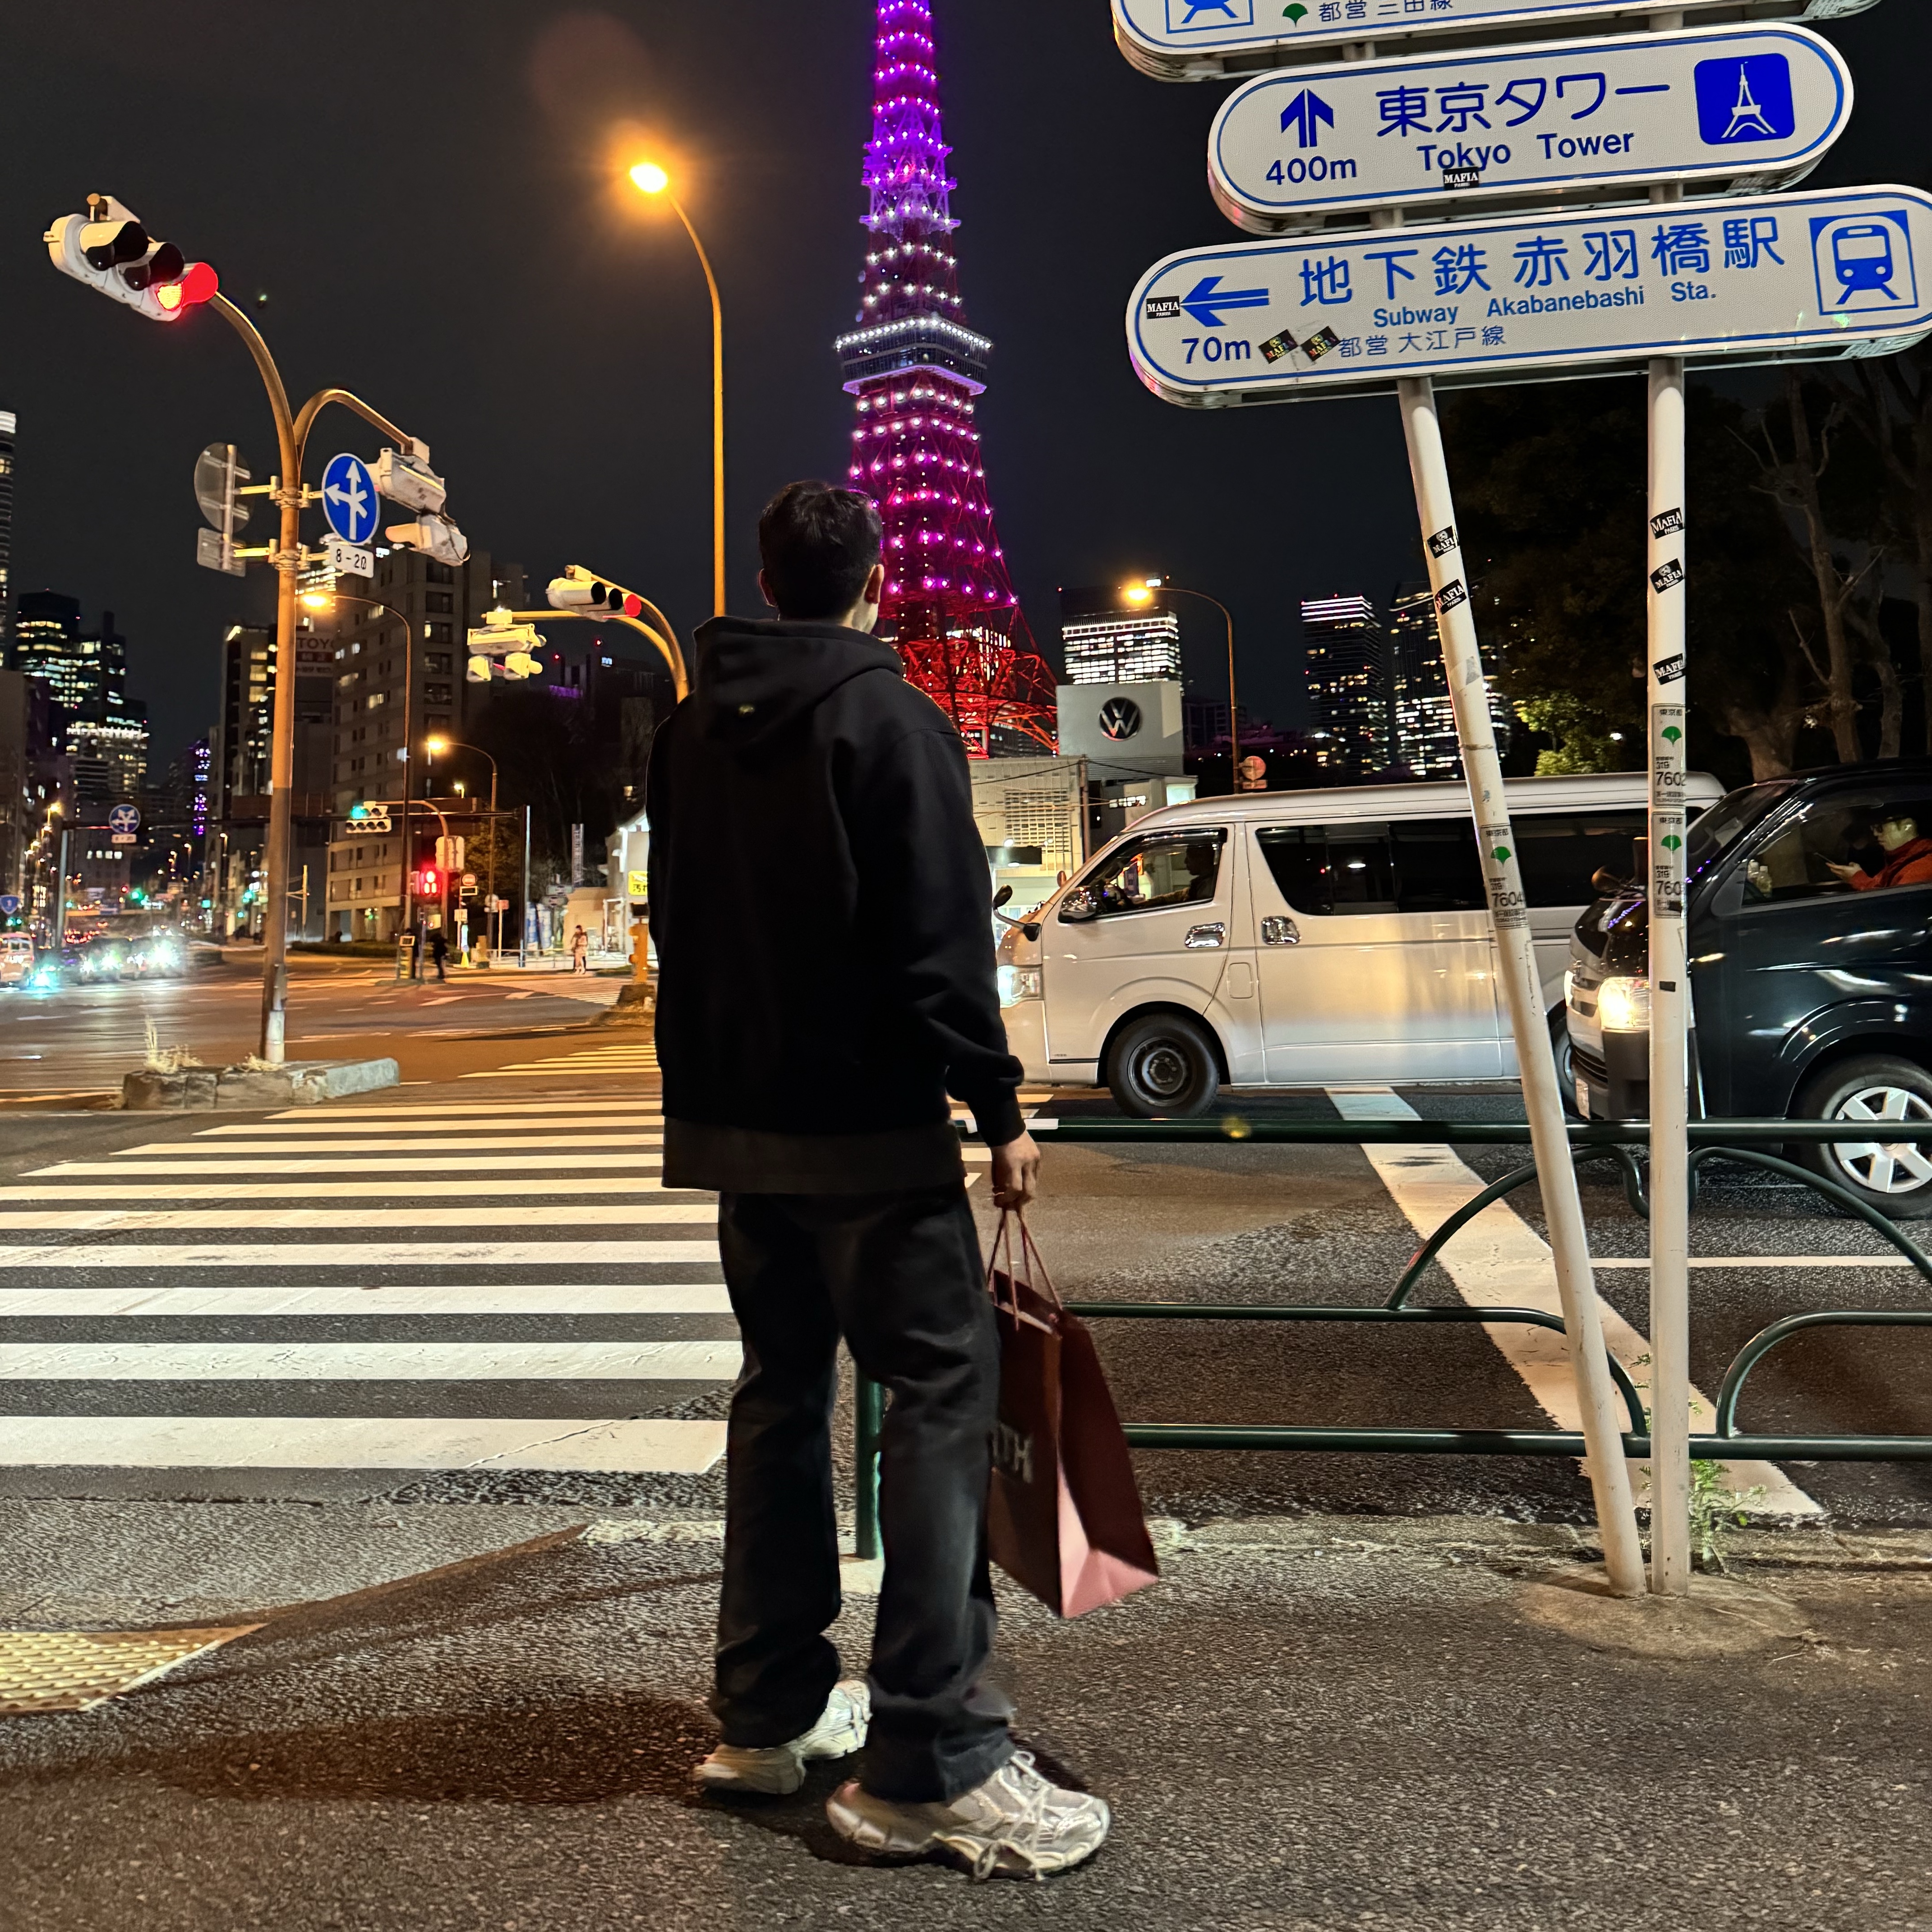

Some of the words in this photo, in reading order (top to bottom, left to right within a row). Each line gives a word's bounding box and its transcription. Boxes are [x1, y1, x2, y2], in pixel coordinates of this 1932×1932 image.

[1376, 73, 1669, 137] 東京タワー
[1416, 143, 1511, 171] Tokyo
[1536, 132, 1634, 159] Tower
[1266, 156, 1357, 185] 400m
[1443, 172, 1478, 184] MAFIA
[1147, 301, 1180, 313] MAFIA
[1373, 307, 1458, 328] Subway
[1487, 286, 1644, 317] Akabanebashi
[1670, 281, 1717, 303] Sta.
[1181, 336, 1251, 364] 70m
[1265, 340, 1295, 359] MAFIA
[1309, 337, 1336, 356] MAFIA
[1651, 511, 1683, 534] MAFIA
[1655, 570, 1682, 589] MAFIA
[296, 638, 334, 649] TOY
